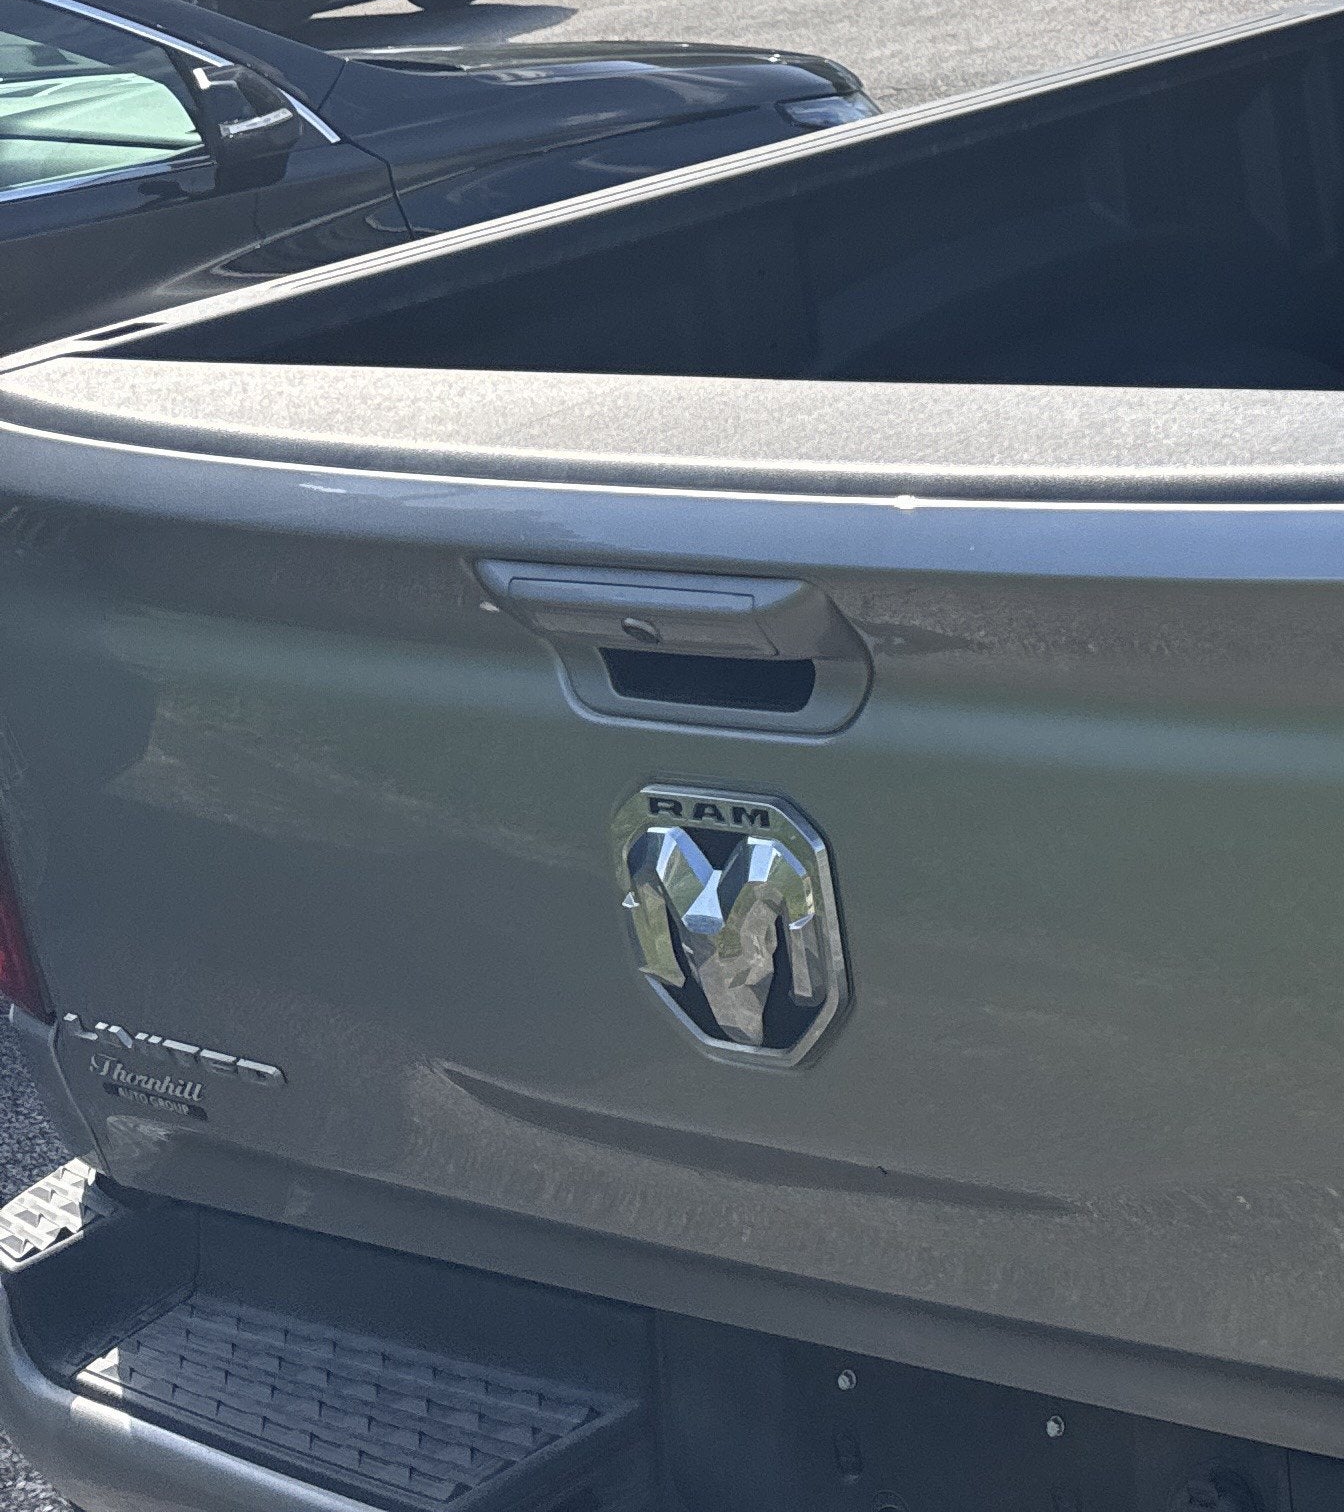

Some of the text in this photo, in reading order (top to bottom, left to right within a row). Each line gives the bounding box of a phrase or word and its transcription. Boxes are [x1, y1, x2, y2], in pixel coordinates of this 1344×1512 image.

[648, 796, 771, 829] RAM
[89, 1052, 204, 1102] Thornhill
[149, 1094, 190, 1116] GROUP
